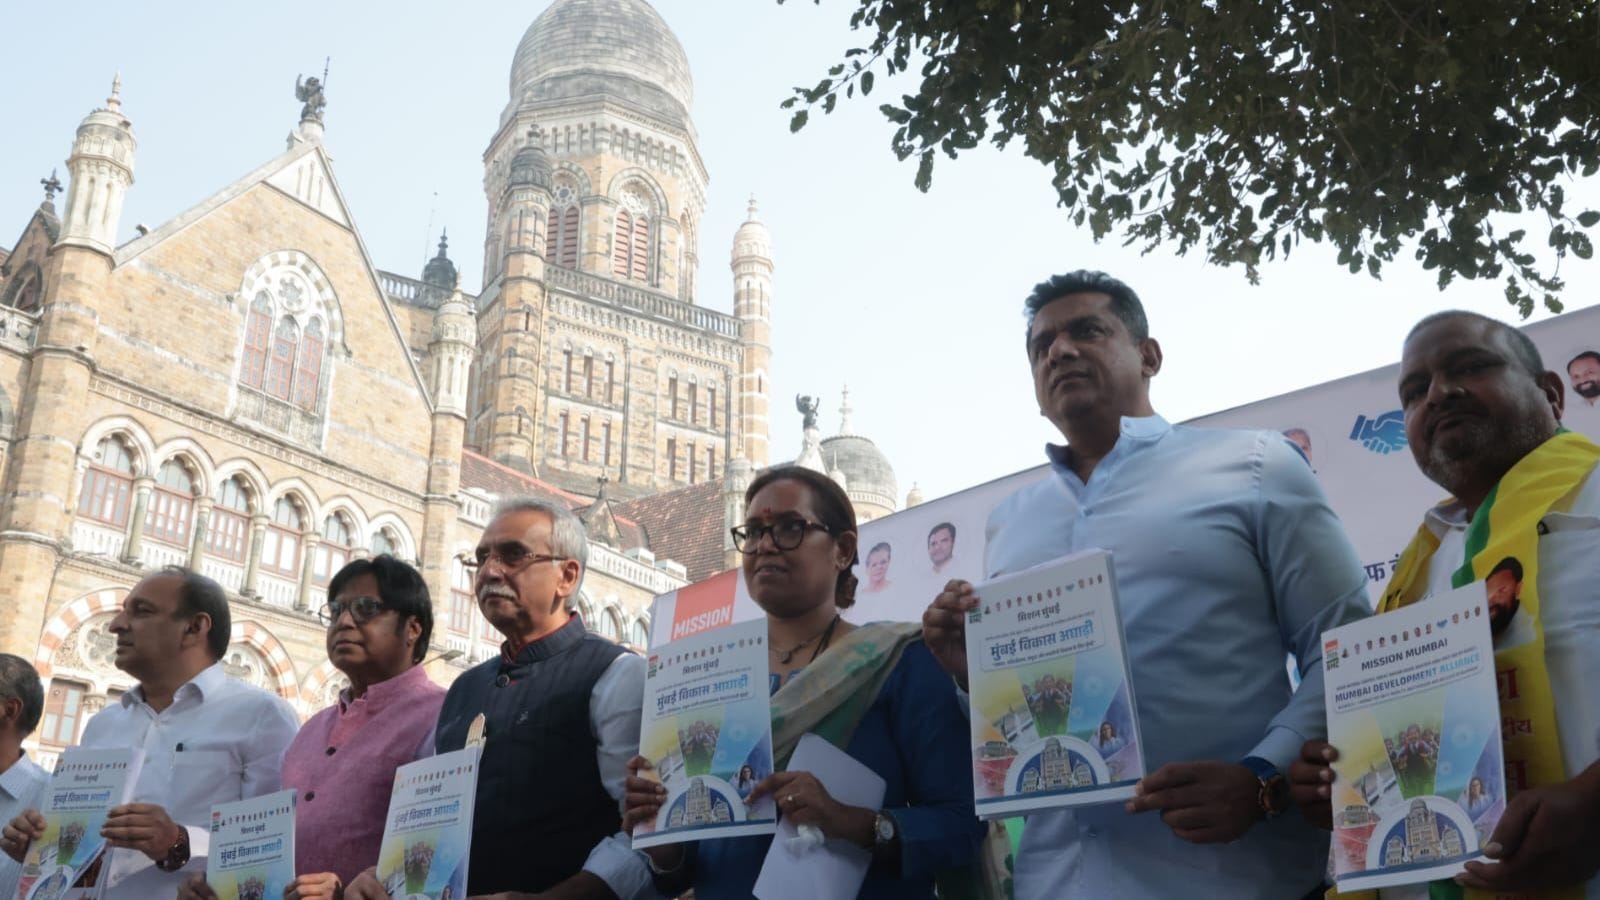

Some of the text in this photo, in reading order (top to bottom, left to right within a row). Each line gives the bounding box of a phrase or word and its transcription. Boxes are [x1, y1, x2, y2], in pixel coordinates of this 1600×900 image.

[673, 603, 731, 640] MISSION
[1042, 602, 1060, 618] मुंबई
[990, 638, 1017, 661] मुंबई
[1019, 632, 1056, 651] विकास
[1361, 652, 1404, 671] MISSION
[1406, 638, 1448, 658] MUMBAI
[1335, 686, 1371, 703] MUMBAI
[1373, 667, 1437, 693] DEVELOPMENT
[1439, 652, 1480, 673] ALLIANCE
[657, 690, 677, 709] मुंबई
[679, 686, 710, 701] विकास
